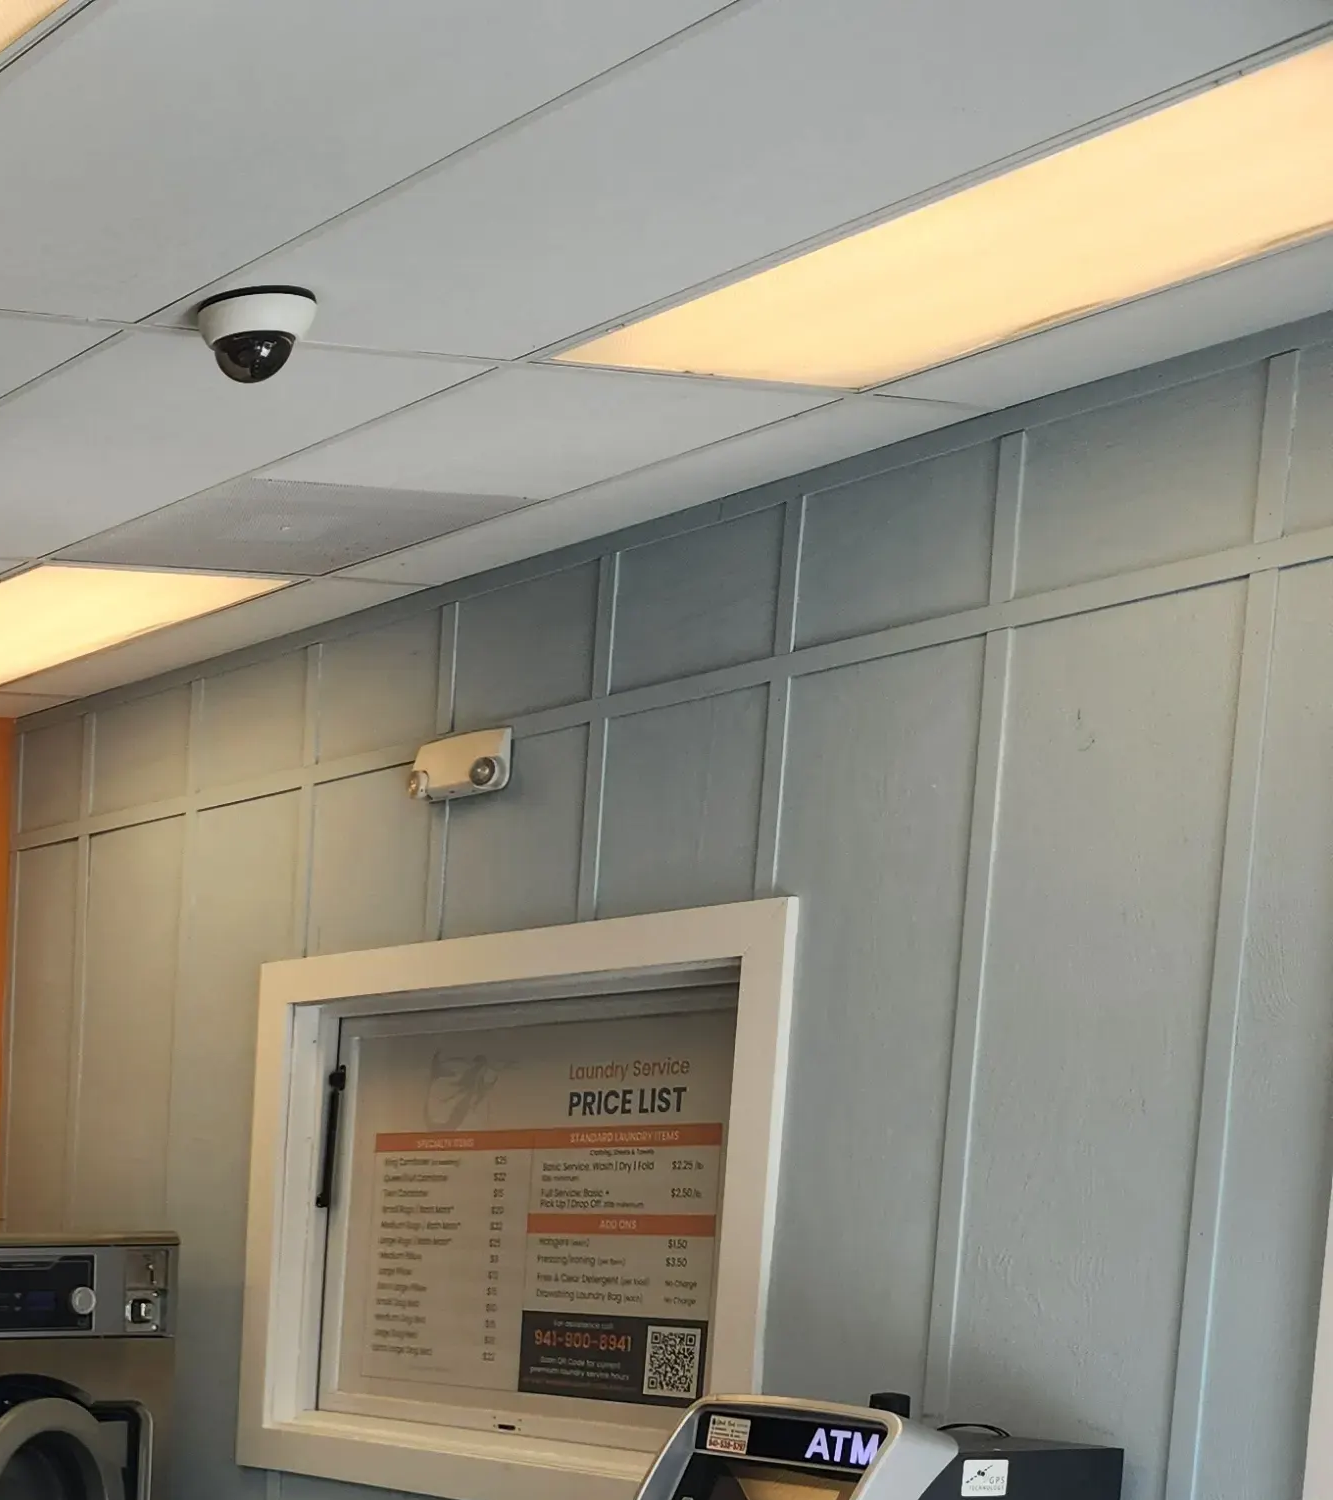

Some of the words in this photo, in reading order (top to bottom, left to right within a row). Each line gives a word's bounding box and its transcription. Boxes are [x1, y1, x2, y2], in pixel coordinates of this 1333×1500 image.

[569, 1061, 629, 1081] Laundry
[633, 1057, 690, 1077] Service
[568, 1089, 633, 1116] PRICE
[638, 1087, 687, 1113] LIST
[570, 1132, 613, 1143] STANDARD
[615, 1130, 652, 1142] LAUNDRY
[655, 1130, 680, 1140] ITEMS
[619, 1161, 632, 1173] Dry
[638, 1161, 655, 1171] Fold
[671, 1160, 693, 1170] $2.25
[671, 1188, 692, 1198] $2.50
[540, 1200, 555, 1208] Pick
[555, 1200, 565, 1210] Up
[571, 1200, 589, 1210] Drop
[599, 1220, 617, 1230] ADD
[619, 1220, 637, 1230] ONS
[667, 1239, 687, 1250] $1.50
[665, 1257, 687, 1268] $3.50
[581, 1274, 619, 1286] Detergent
[674, 1280, 697, 1290] Charge
[607, 1292, 622, 1304] Bag
[804, 1428, 879, 1466] ATM
[989, 1476, 1005, 1484] GPS
